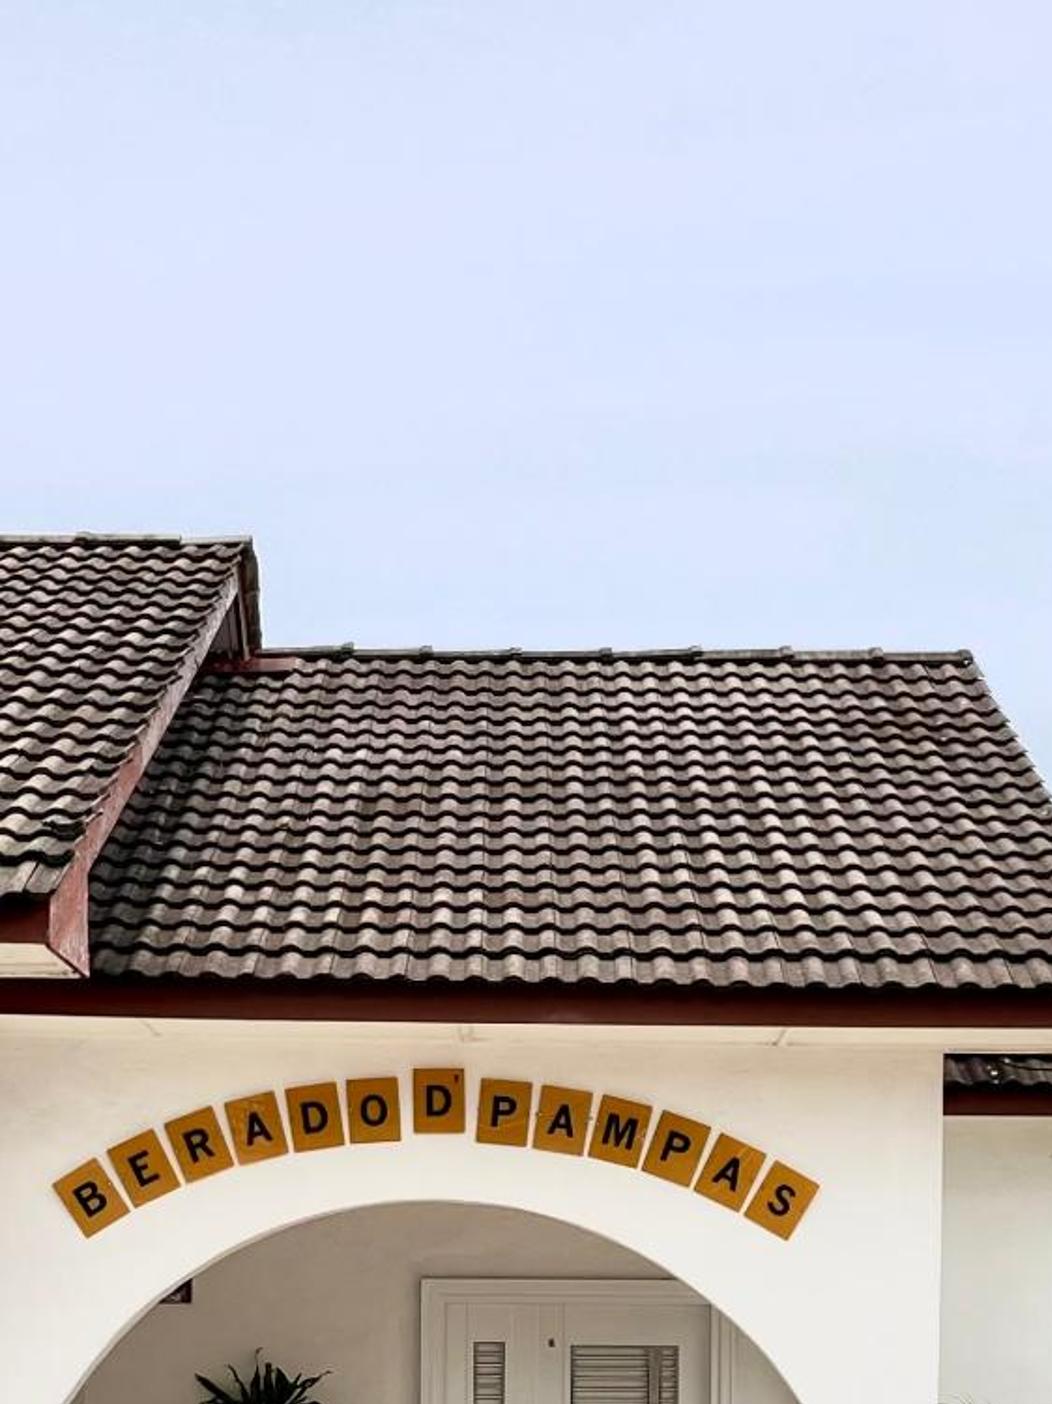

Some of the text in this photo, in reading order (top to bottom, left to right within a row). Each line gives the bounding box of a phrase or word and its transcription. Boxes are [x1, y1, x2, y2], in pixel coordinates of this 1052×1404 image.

[72, 1074, 796, 1219] BERADO D' PAMPAS
